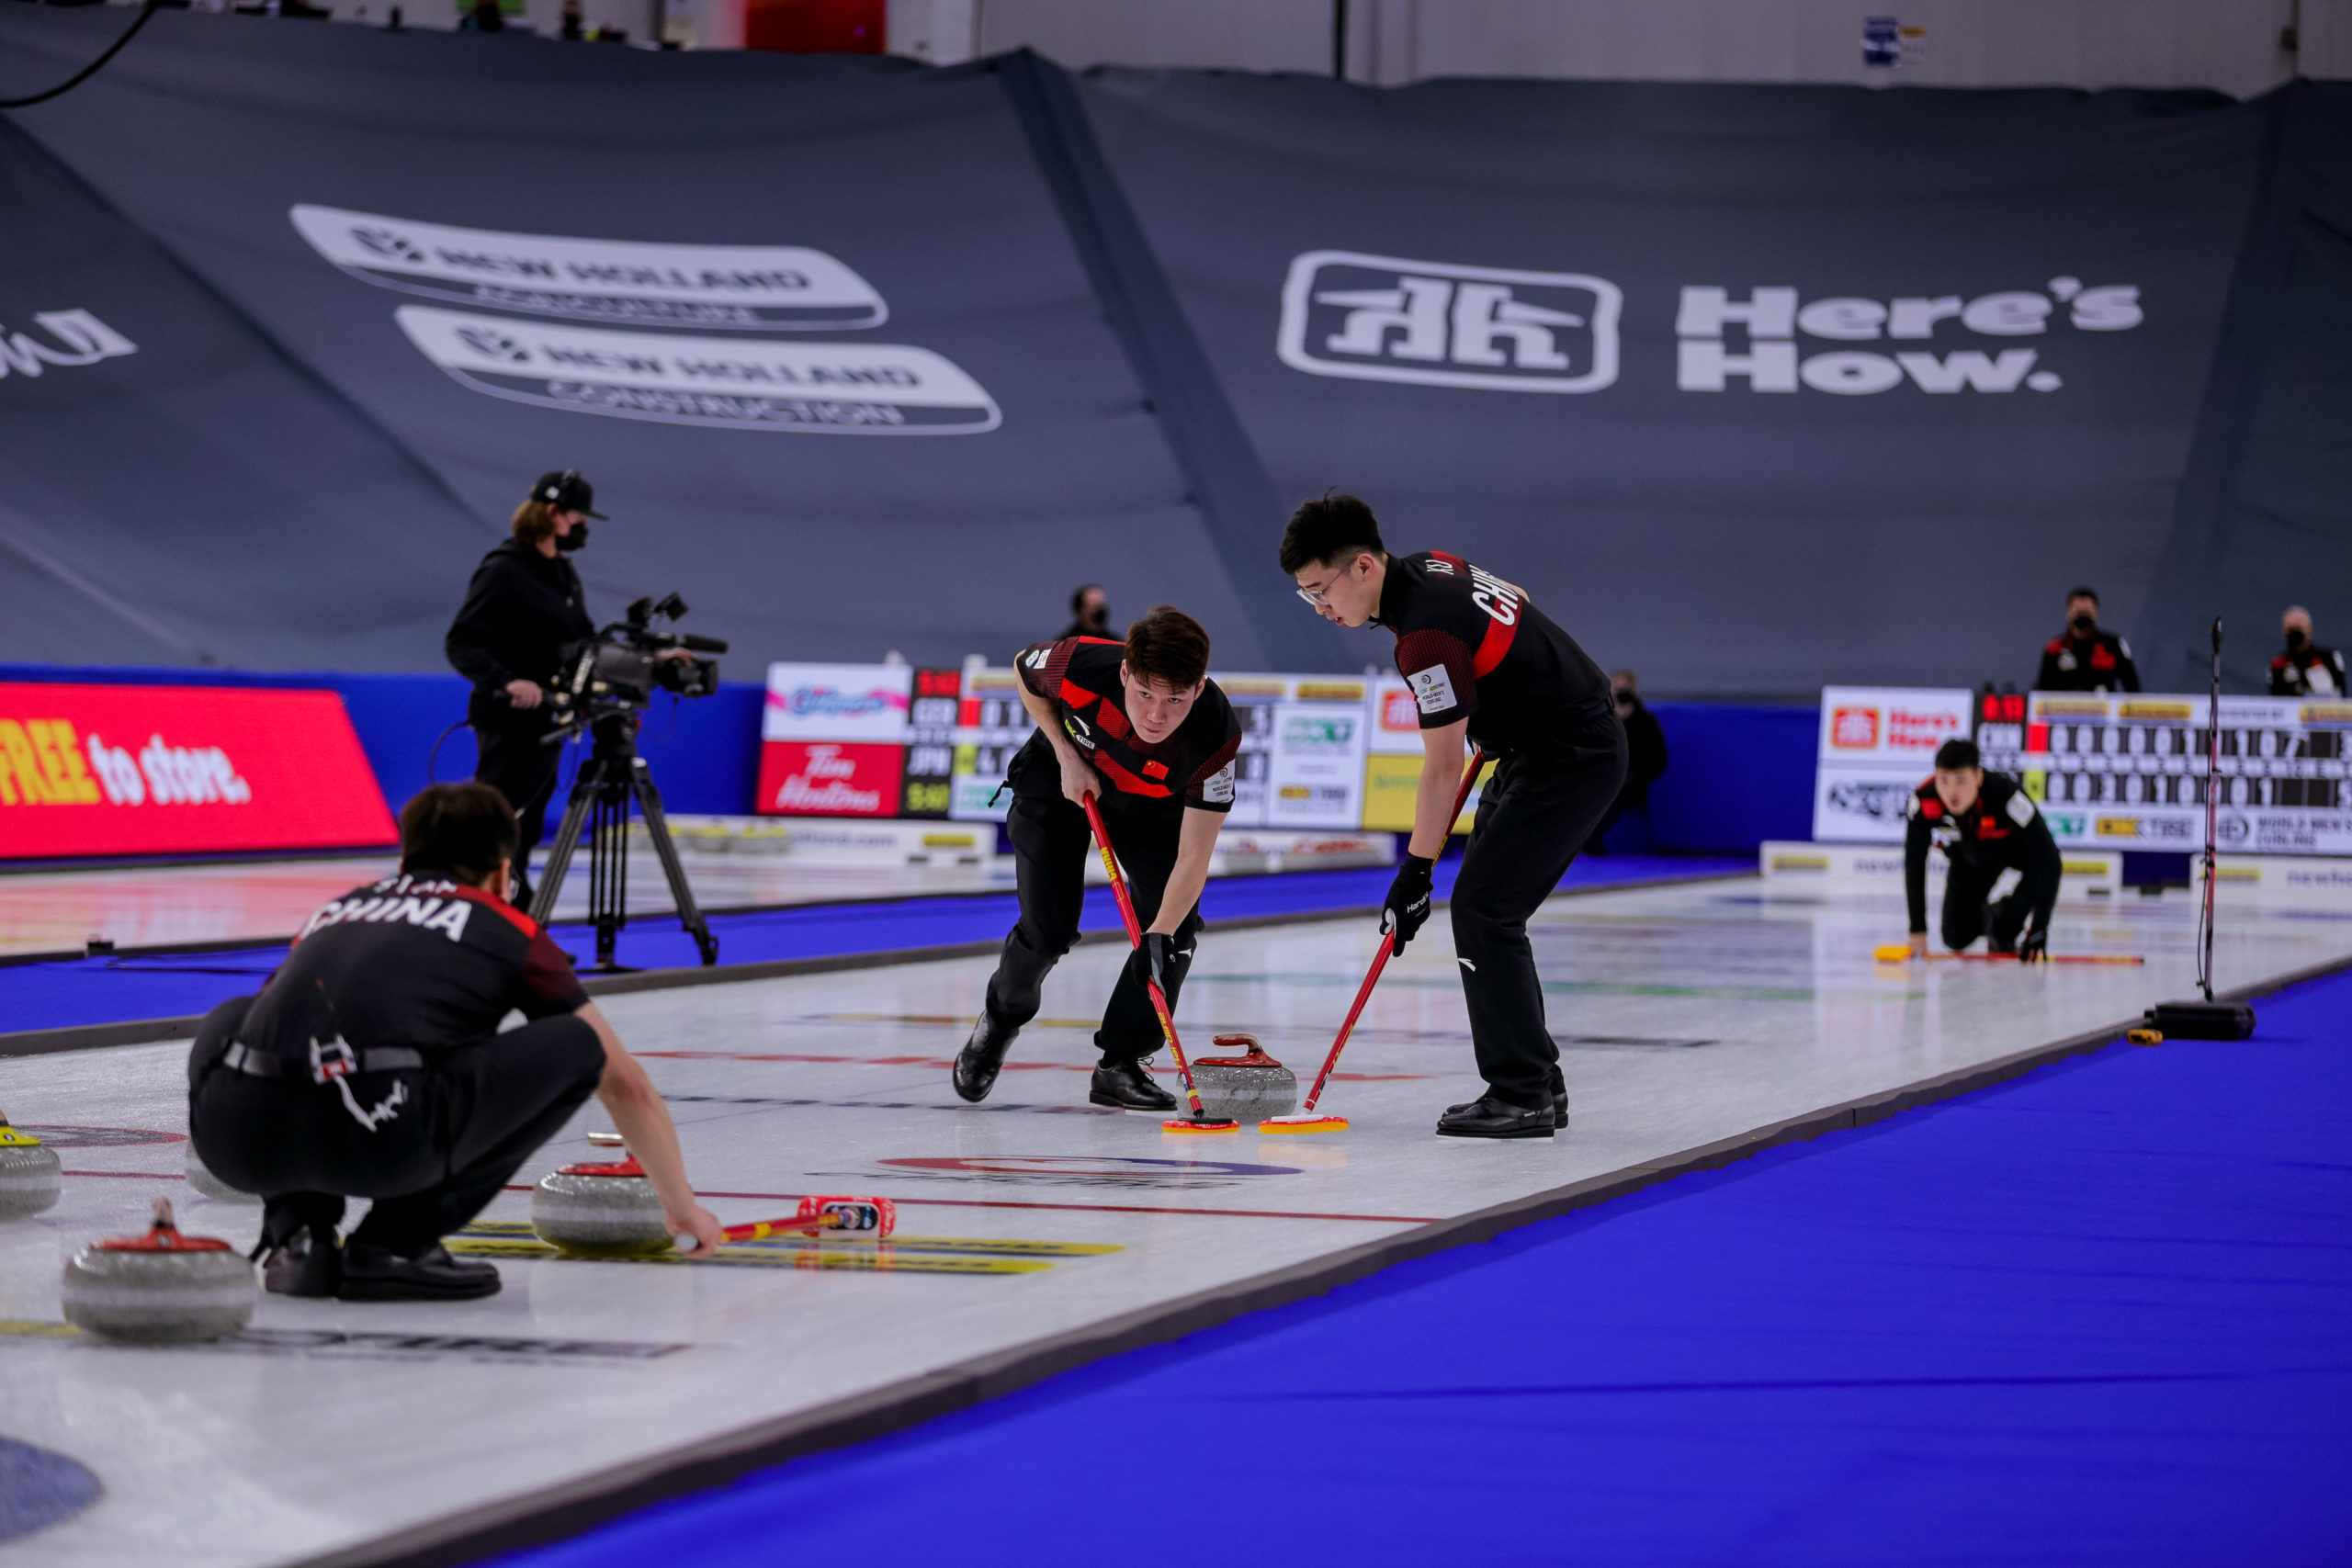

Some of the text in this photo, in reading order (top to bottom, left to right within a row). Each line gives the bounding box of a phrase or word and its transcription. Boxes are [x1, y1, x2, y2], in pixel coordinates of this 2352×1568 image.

[436, 246, 812, 292] NEW HOLLAND
[1675, 276, 2144, 340] Here's
[543, 344, 922, 389] NEW HOLLAND
[1676, 338, 2063, 395] How.
[547, 378, 907, 427] CONSTRUCTION
[1468, 564, 1520, 626] CHIN
[1078, 735, 1095, 750] TIRE
[87, 732, 145, 806] to
[140, 732, 252, 806] store.
[300, 896, 472, 942] CHINA
